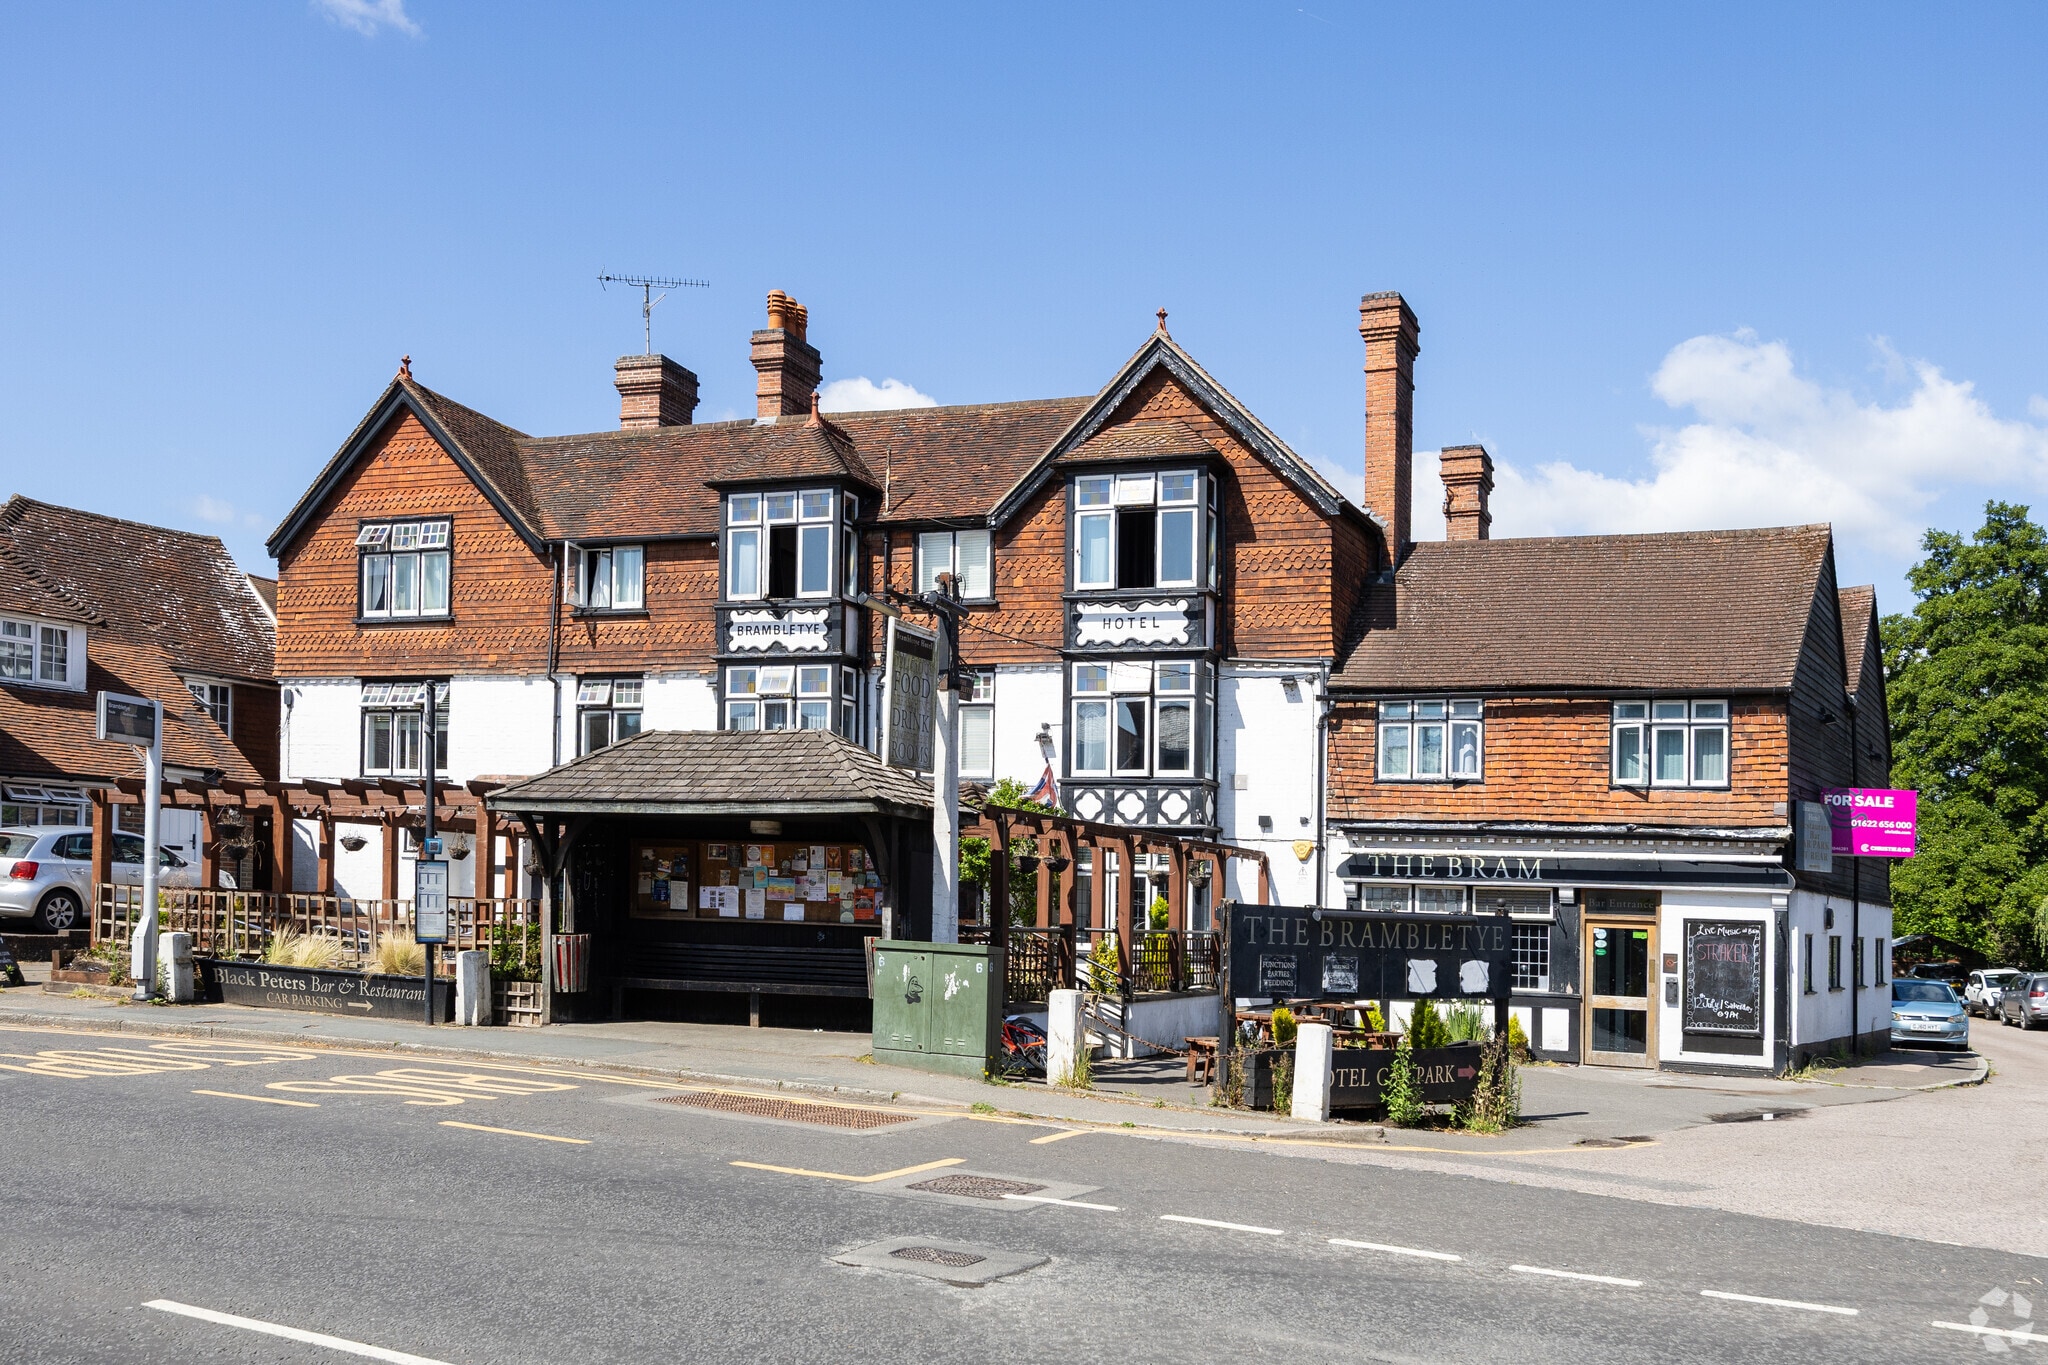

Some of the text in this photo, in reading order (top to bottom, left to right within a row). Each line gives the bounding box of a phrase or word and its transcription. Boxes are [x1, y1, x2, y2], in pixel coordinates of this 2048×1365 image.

[737, 623, 820, 636] BRAMBLETYE
[1103, 616, 1160, 629] HOTEL
[894, 670, 931, 699] FOOD
[892, 707, 930, 733] DRINK
[891, 740, 929, 763] ROOMS
[1824, 794, 1895, 808] FOR SALE
[1851, 819, 1912, 829] 01622 656 000
[1368, 854, 1543, 880] THE BRAM
[1243, 915, 1505, 951] THE BRAMBLETYE
[1696, 943, 1751, 964] STRAKER
[975, 962, 983, 973] 6
[1262, 961, 1296, 969] FUNCTIONS
[1267, 970, 1290, 978] PARTIES
[212, 967, 256, 987] Black
[258, 971, 306, 991] Peters
[311, 975, 335, 993] Bar
[338, 978, 355, 994] &
[1262, 979, 1294, 987] WEDDINGS
[266, 991, 343, 1009] CAR PARKING
[1416, 1065, 1456, 1085] PARK
